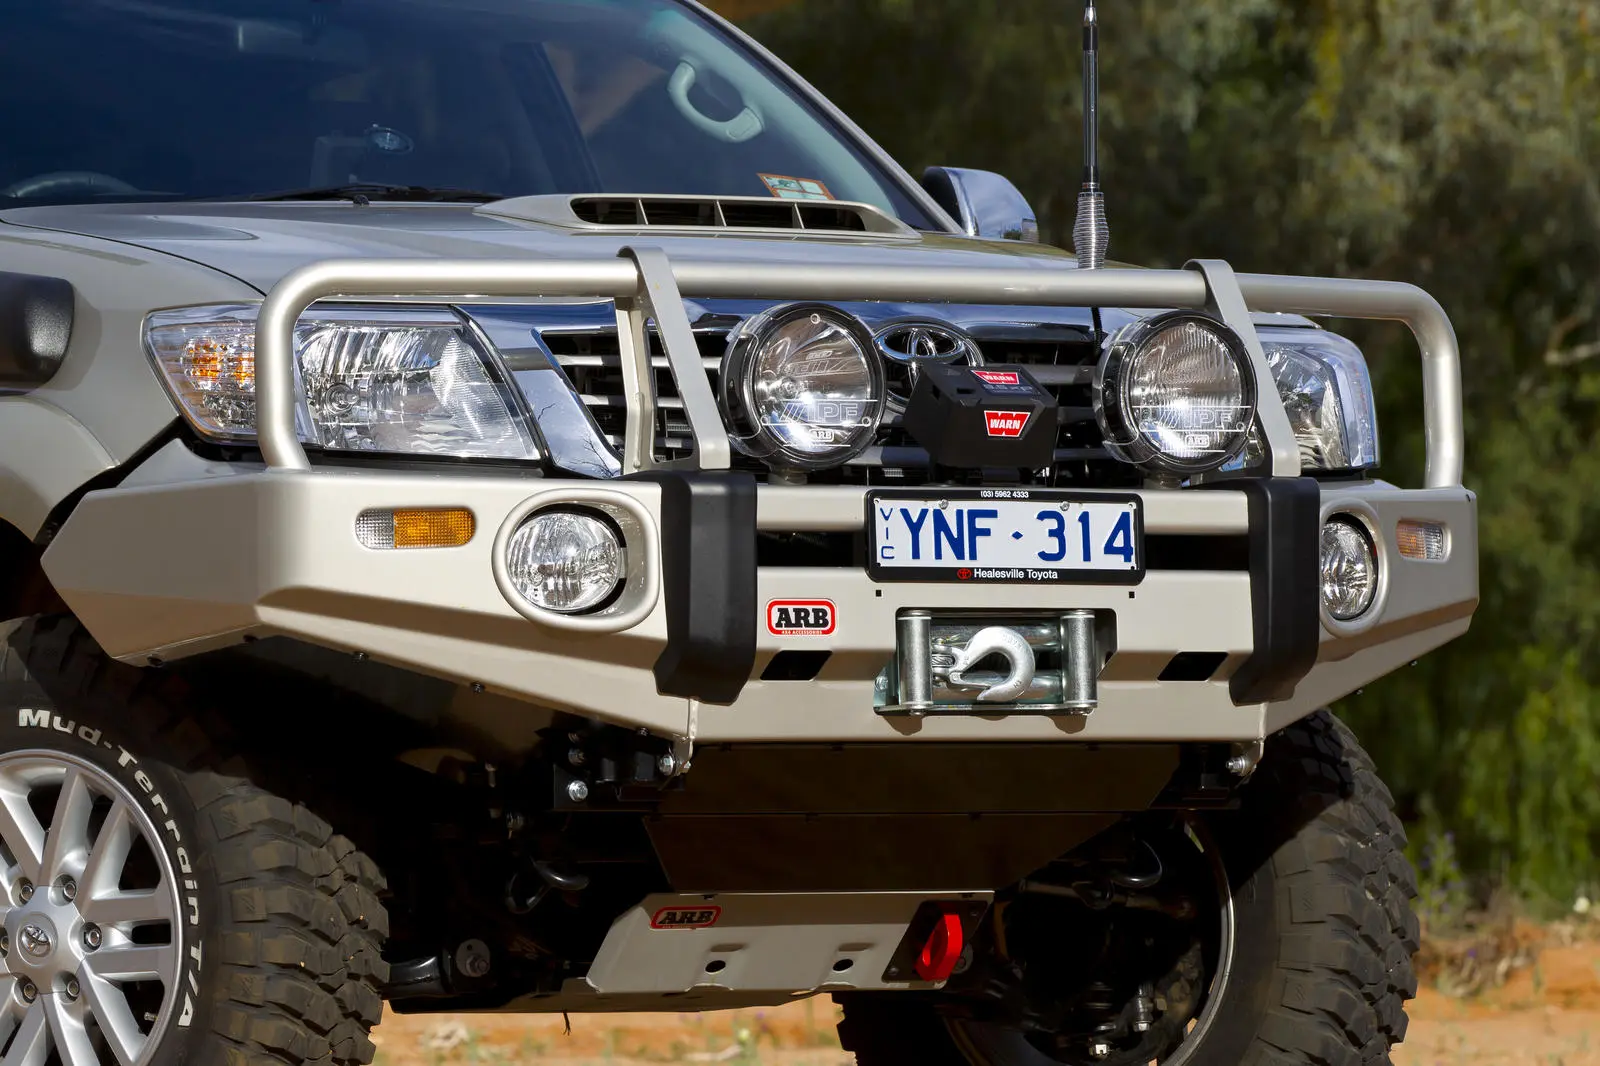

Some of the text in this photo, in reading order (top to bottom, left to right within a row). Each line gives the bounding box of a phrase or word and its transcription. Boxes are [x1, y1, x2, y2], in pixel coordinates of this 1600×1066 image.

[990, 419, 1020, 429] WARN
[980, 490, 1029, 499] (03) 5962 4333
[973, 568, 1058, 580] Healesville Toyota
[775, 607, 829, 628] ARB
[18, 708, 202, 1027] Mud-Terrain T/A
[657, 911, 714, 924] ARB
